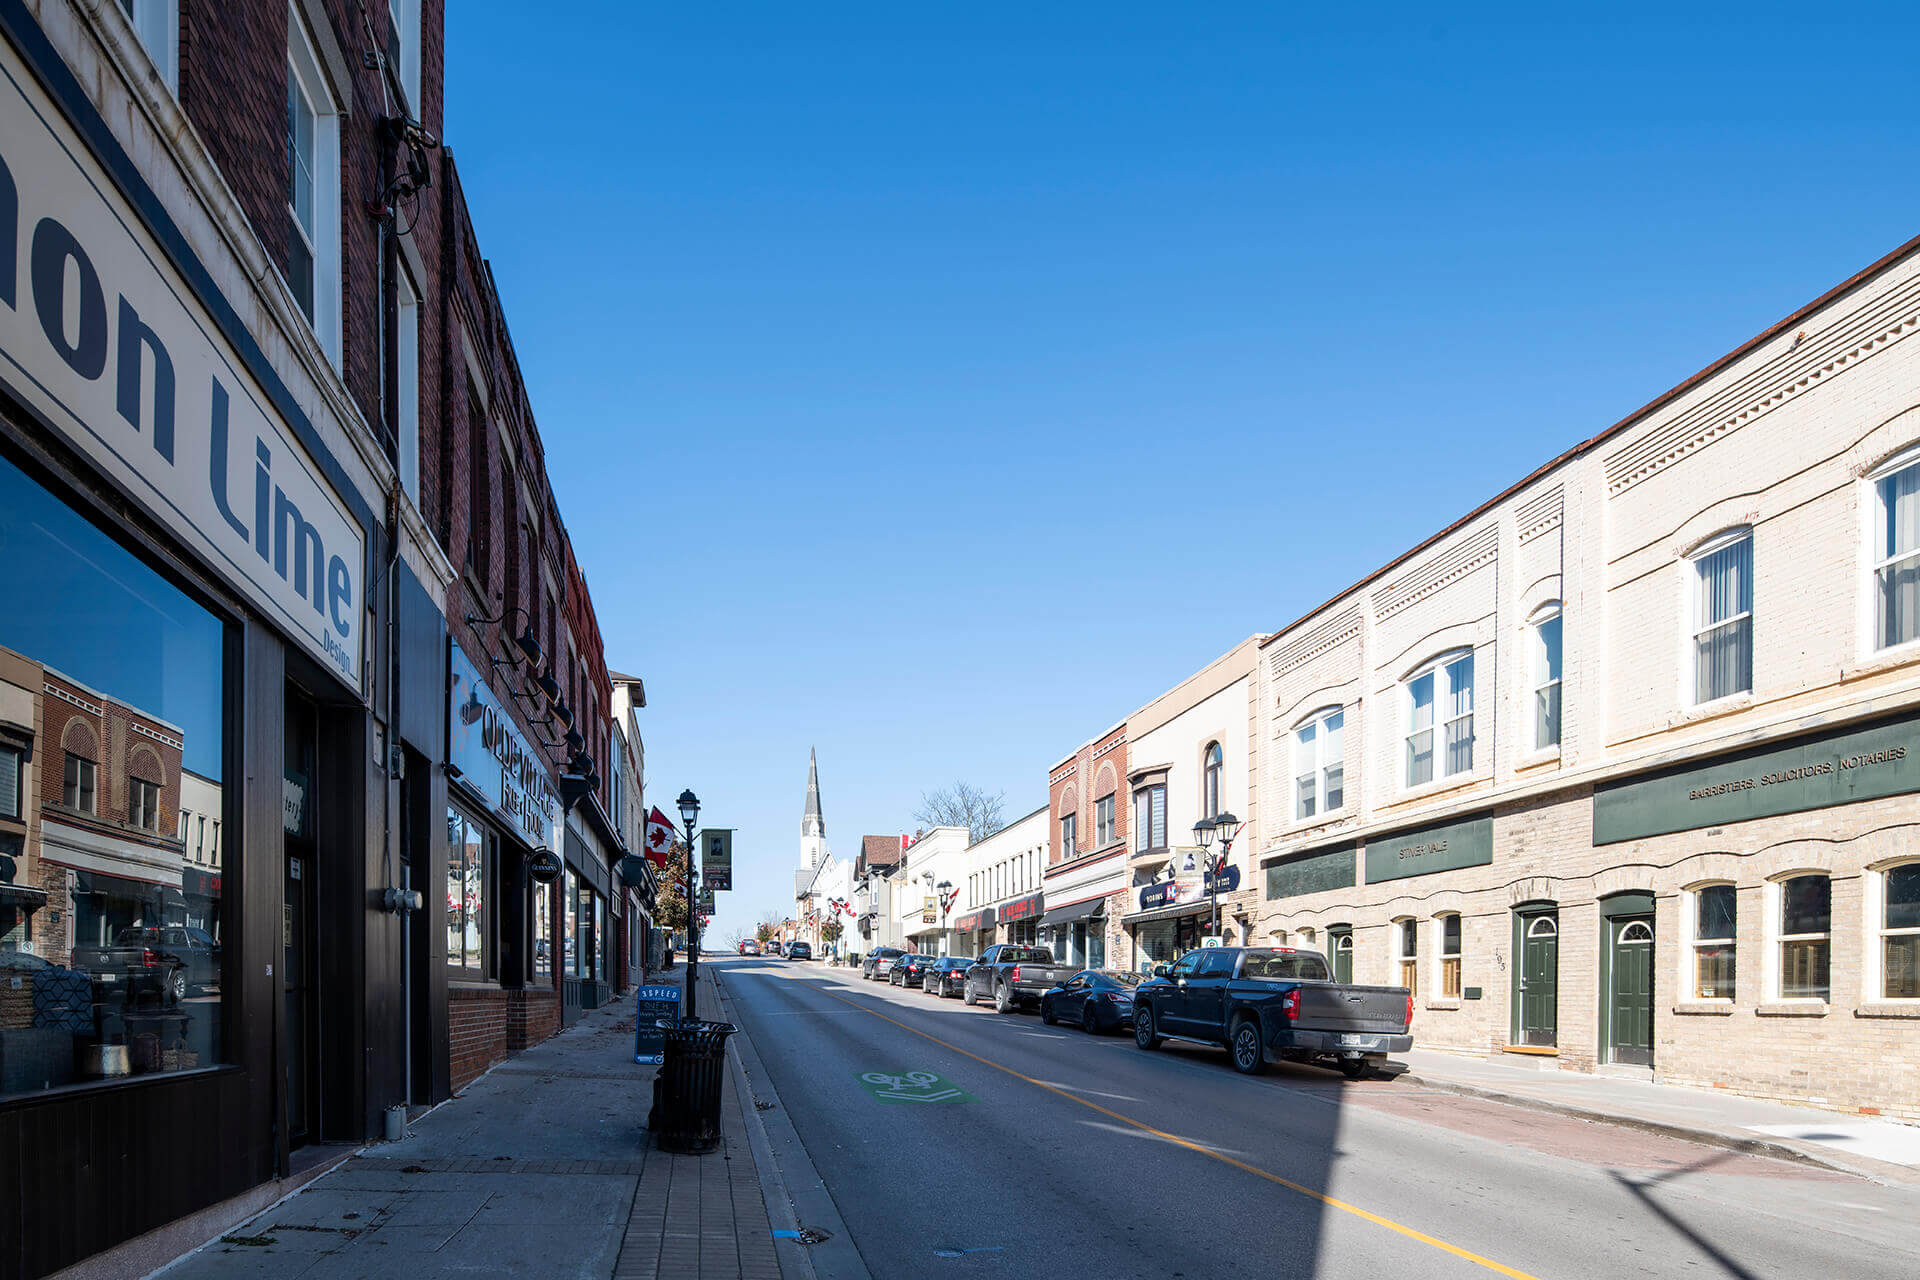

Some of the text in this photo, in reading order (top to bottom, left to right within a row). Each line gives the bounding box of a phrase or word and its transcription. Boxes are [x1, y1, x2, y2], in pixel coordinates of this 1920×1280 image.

[0, 154, 352, 638] on Lime
[322, 628, 350, 678] Design
[483, 704, 554, 822] OLDE VILLAGE
[1839, 746, 1906, 771] NOTARIES
[1427, 840, 1448, 854] VALE
